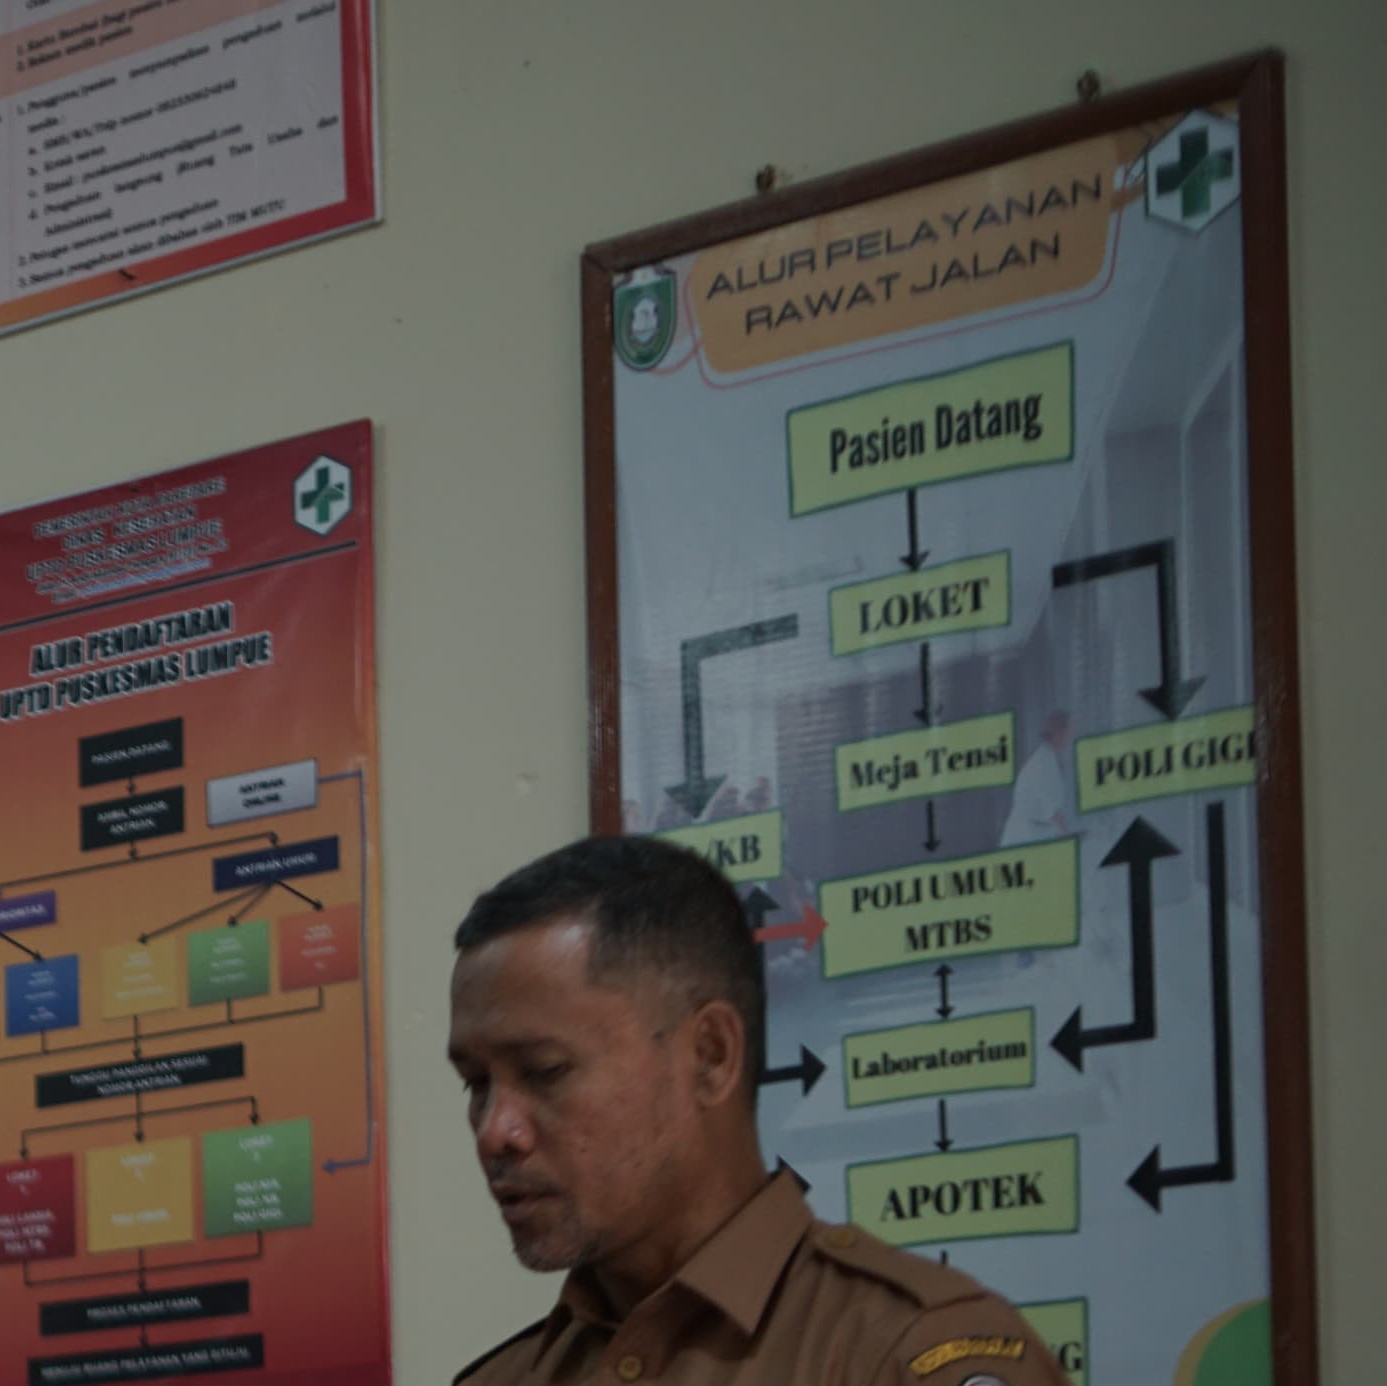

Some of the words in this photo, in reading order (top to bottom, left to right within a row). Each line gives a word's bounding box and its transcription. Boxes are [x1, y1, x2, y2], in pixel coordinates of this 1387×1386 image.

[708, 250, 817, 300] ALUR
[826, 174, 1102, 269] PELAYANAN
[744, 273, 901, 336] RAWAT
[911, 233, 1062, 294] JALAN
[830, 415, 925, 474] Pasien
[935, 392, 1043, 444] Datang
[859, 577, 990, 635] LOKET
[29, 635, 83, 677] ALUR
[84, 600, 235, 664] PENDAFTARAN
[54, 652, 183, 711] PUSKESMAS
[184, 630, 274, 683] LUMPUE
[849, 755, 919, 791] Meja
[927, 734, 1008, 777] Tensi
[1094, 745, 1174, 786] POLI
[850, 881, 924, 914] POLI
[903, 916, 994, 953] MTBS
[851, 1037, 1028, 1080] Laboratorium
[879, 1171, 1045, 1224] APOTEK
